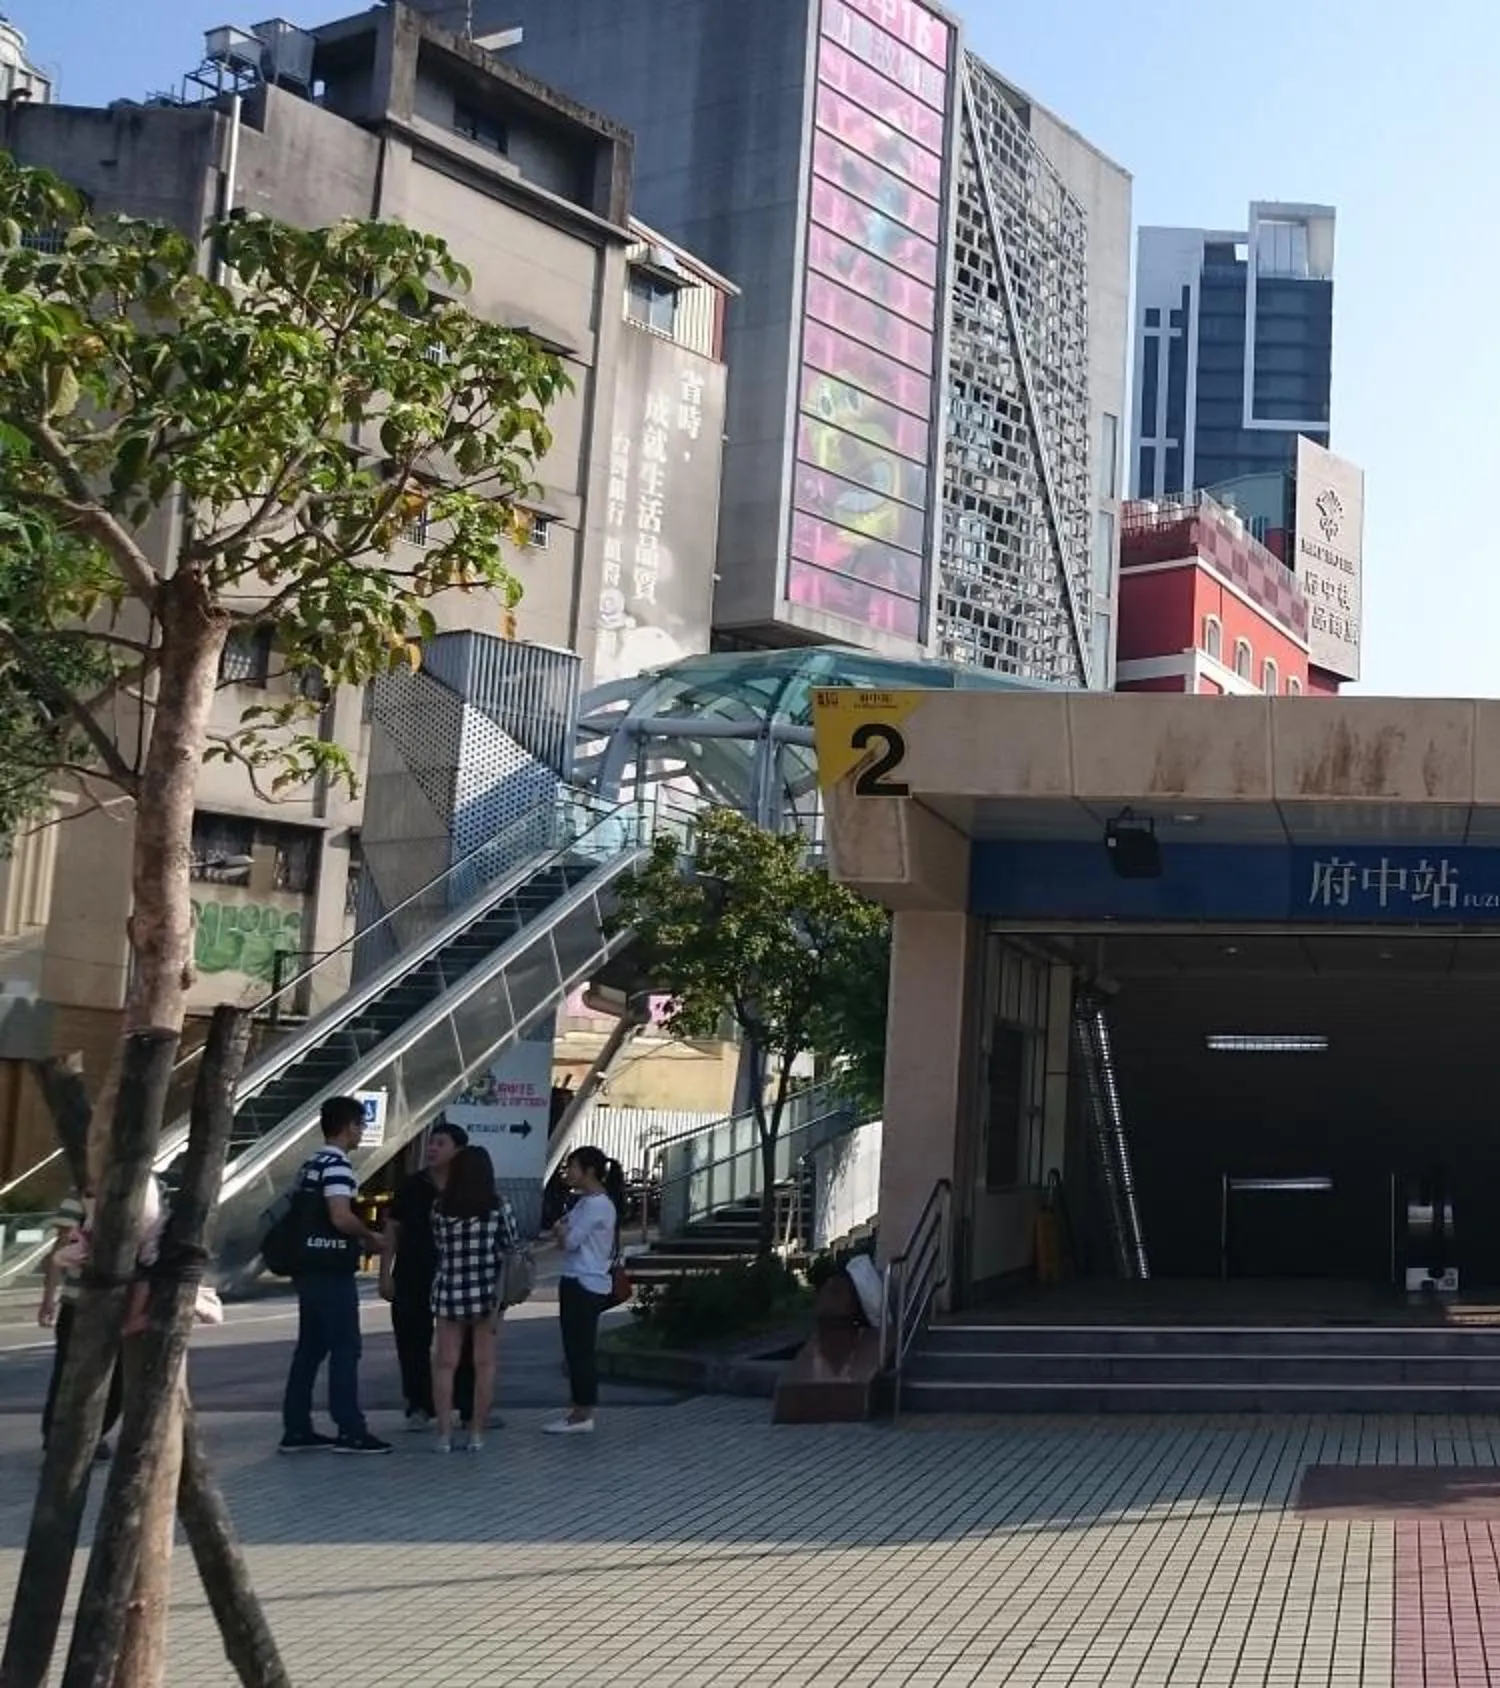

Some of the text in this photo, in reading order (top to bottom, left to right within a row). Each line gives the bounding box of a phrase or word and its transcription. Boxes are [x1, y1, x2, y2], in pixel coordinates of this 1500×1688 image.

[851, 723, 909, 796] 2
[1308, 856, 1460, 909] 府中站
